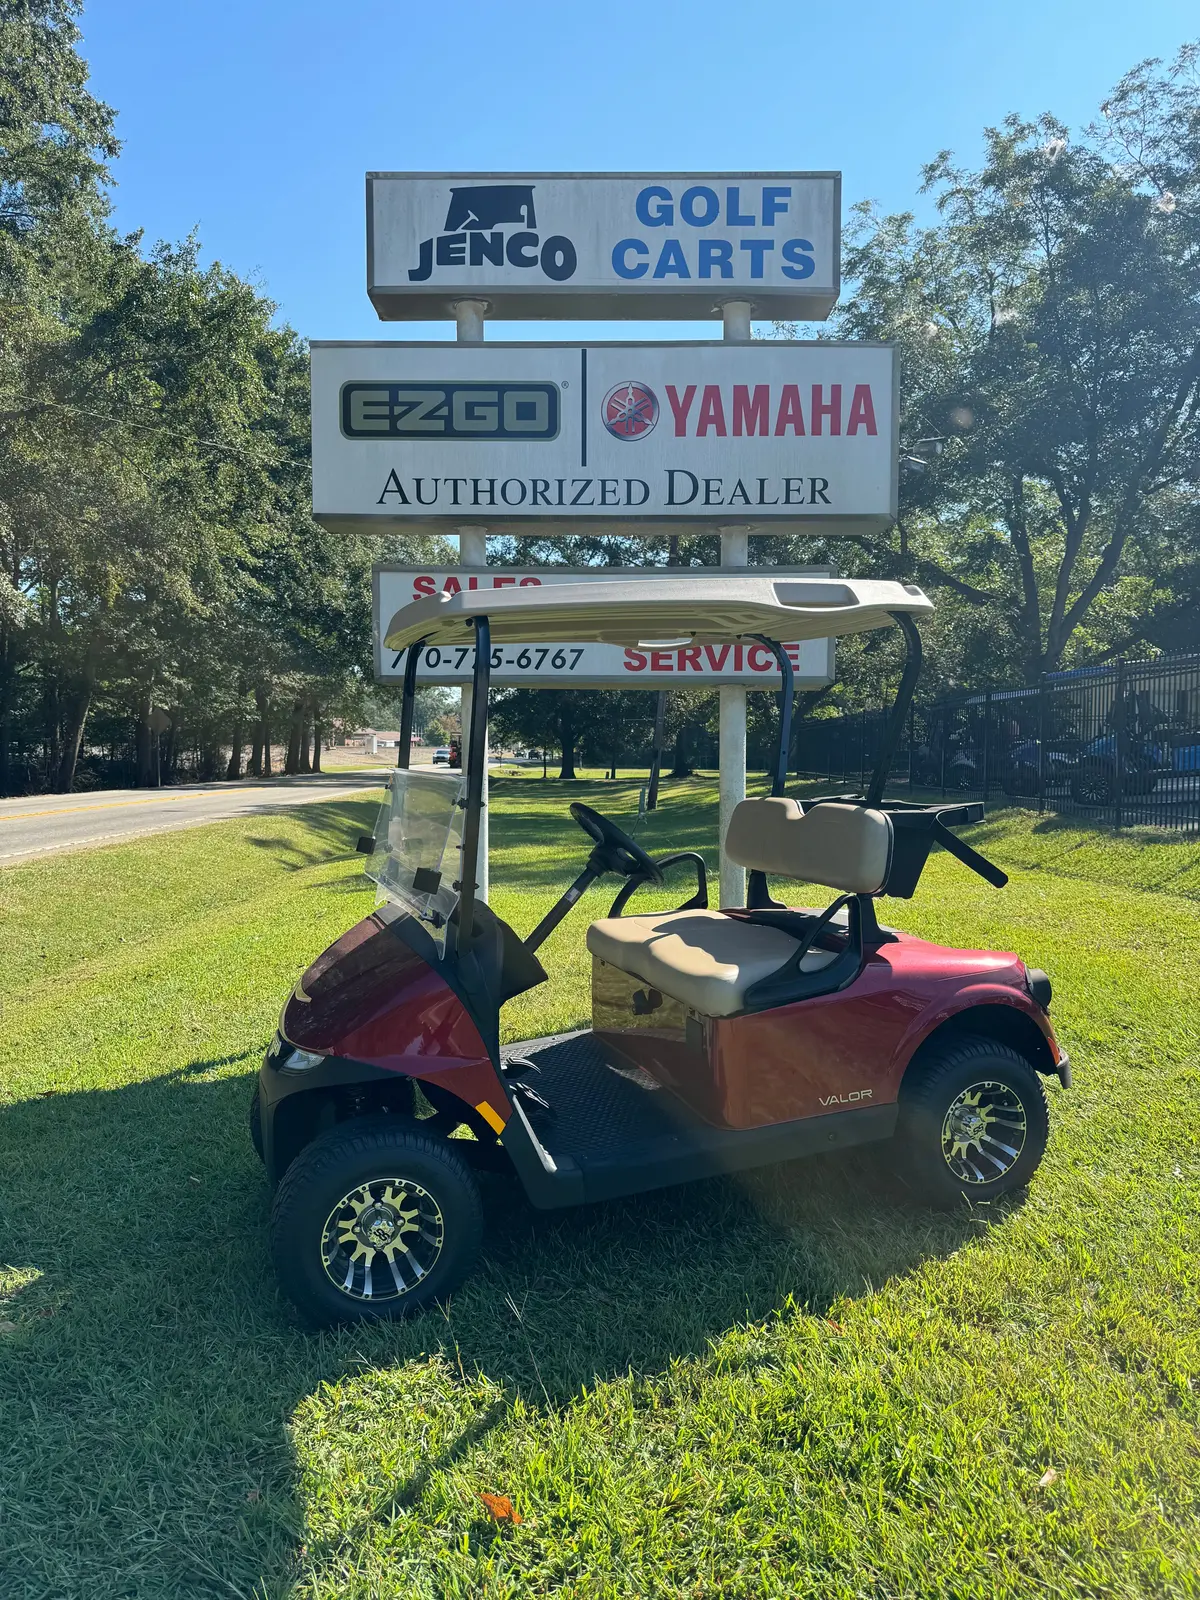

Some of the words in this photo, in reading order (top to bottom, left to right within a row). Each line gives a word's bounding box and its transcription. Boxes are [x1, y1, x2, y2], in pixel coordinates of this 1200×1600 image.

[635, 186, 792, 227] GOLF
[408, 231, 577, 281] JENCO
[611, 238, 816, 279] CARTS
[664, 384, 878, 437] YAMAHA
[376, 467, 650, 506] AUTHORIZED
[664, 469, 832, 506] DEALER
[818, 1089, 873, 1106] VALOR
